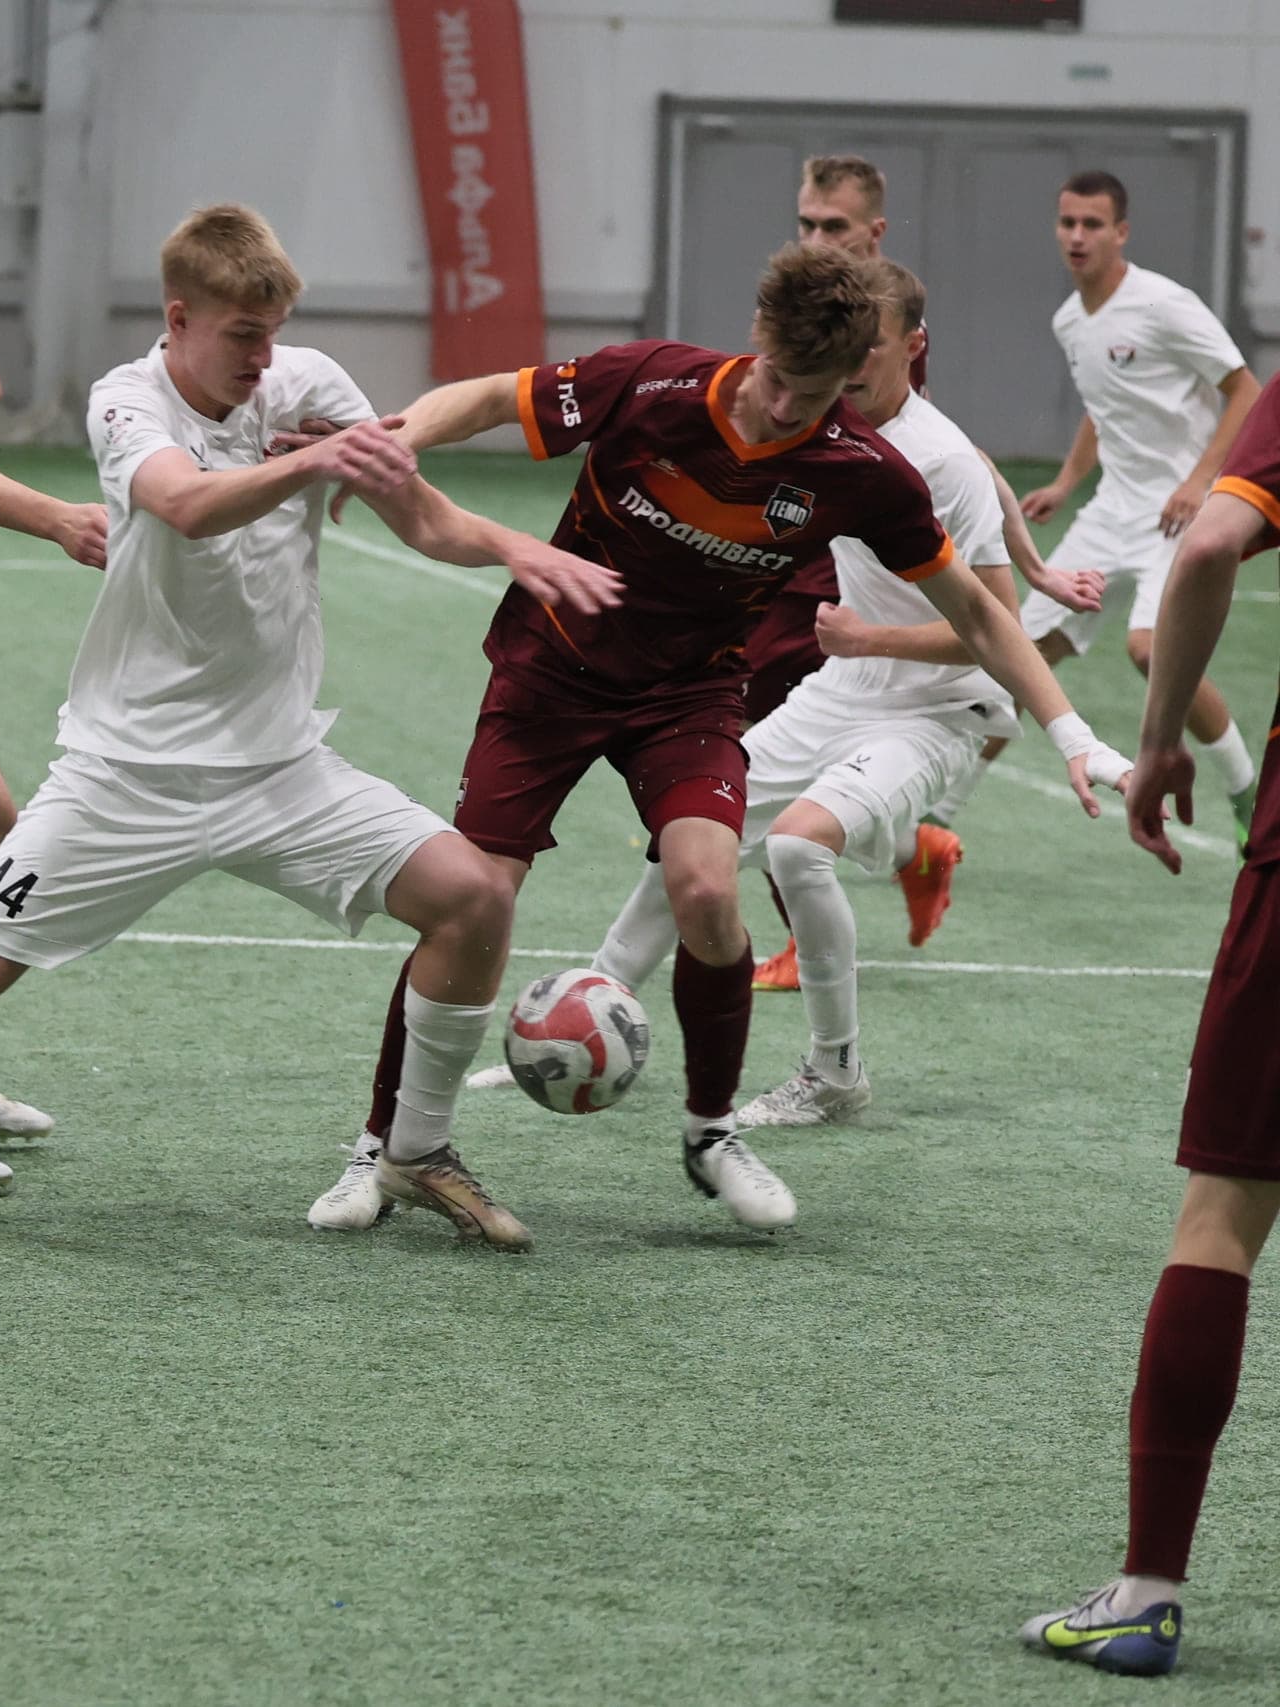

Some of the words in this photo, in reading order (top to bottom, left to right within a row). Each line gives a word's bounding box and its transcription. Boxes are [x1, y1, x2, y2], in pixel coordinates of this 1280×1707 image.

[557, 383, 582, 428] ПСБ
[618, 486, 793, 570] ПРОДИНВЕСТ
[770, 499, 808, 526] ТЕМП
